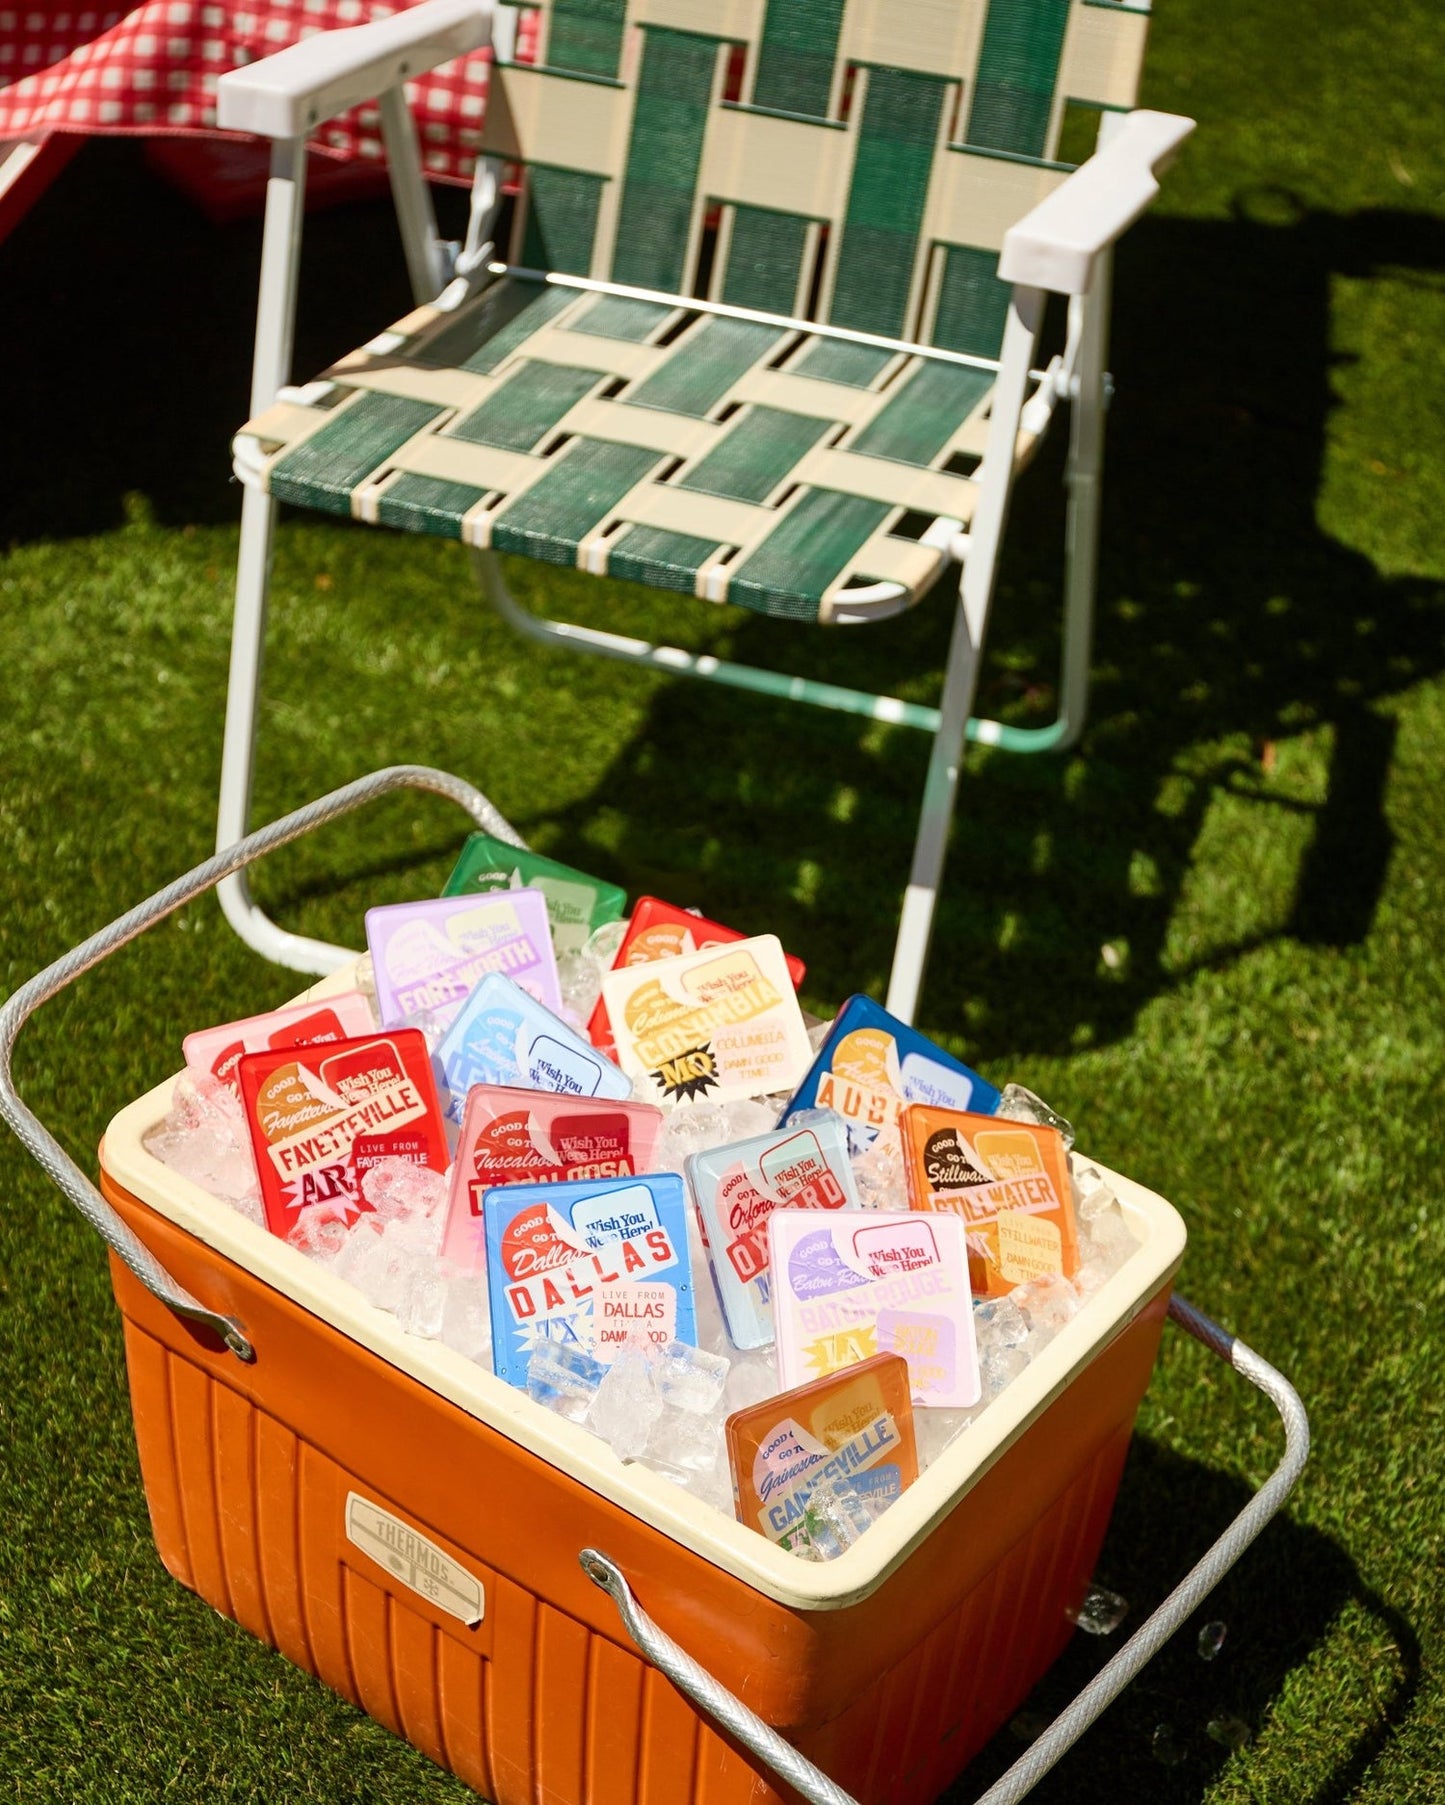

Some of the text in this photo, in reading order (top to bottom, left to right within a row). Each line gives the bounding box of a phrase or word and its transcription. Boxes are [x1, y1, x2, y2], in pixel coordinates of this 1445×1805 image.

[641, 979, 781, 1063] COLUMBIA
[336, 1066, 393, 1092] Wish You
[537, 1058, 564, 1082] Wish
[563, 1073, 584, 1094] You
[658, 1052, 714, 1088] MO
[266, 1075, 297, 1100] GOOD
[368, 1075, 402, 1096] Here!
[286, 1092, 304, 1104] GO
[278, 1086, 419, 1172] FAYETTEVILLE
[490, 1121, 525, 1138] GOOD
[360, 1141, 419, 1154] LIVE FROM
[506, 1137, 523, 1147] GO
[560, 1136, 619, 1150] Wish You
[931, 1138, 955, 1153] GOOD
[589, 1147, 625, 1160] Here!
[946, 1153, 960, 1163] GO
[774, 1158, 817, 1186] Wish You
[799, 1165, 825, 1188] Here!
[302, 1163, 355, 1208] AR
[722, 1174, 743, 1198] GOOD
[737, 1190, 750, 1201] GO
[934, 1176, 1054, 1223] STILLWATER
[513, 1216, 544, 1238] GOOD
[586, 1212, 646, 1237] Wish You
[620, 1221, 654, 1241] Here!
[531, 1233, 548, 1244] GO
[1000, 1227, 1060, 1252] STILLWATER
[799, 1241, 828, 1259] GOOD
[868, 1247, 926, 1264] Wish You
[817, 1257, 833, 1266] GO
[900, 1256, 934, 1272] Here!
[508, 1231, 673, 1319] DALLAS
[602, 1290, 665, 1300] LIVE FROM
[801, 1269, 952, 1334] BATON ROUGE
[604, 1302, 665, 1319] DALLAS
[535, 1313, 580, 1346] TX
[850, 1402, 873, 1418] You
[762, 1433, 788, 1460] GOOD
[778, 1449, 793, 1460] GO
